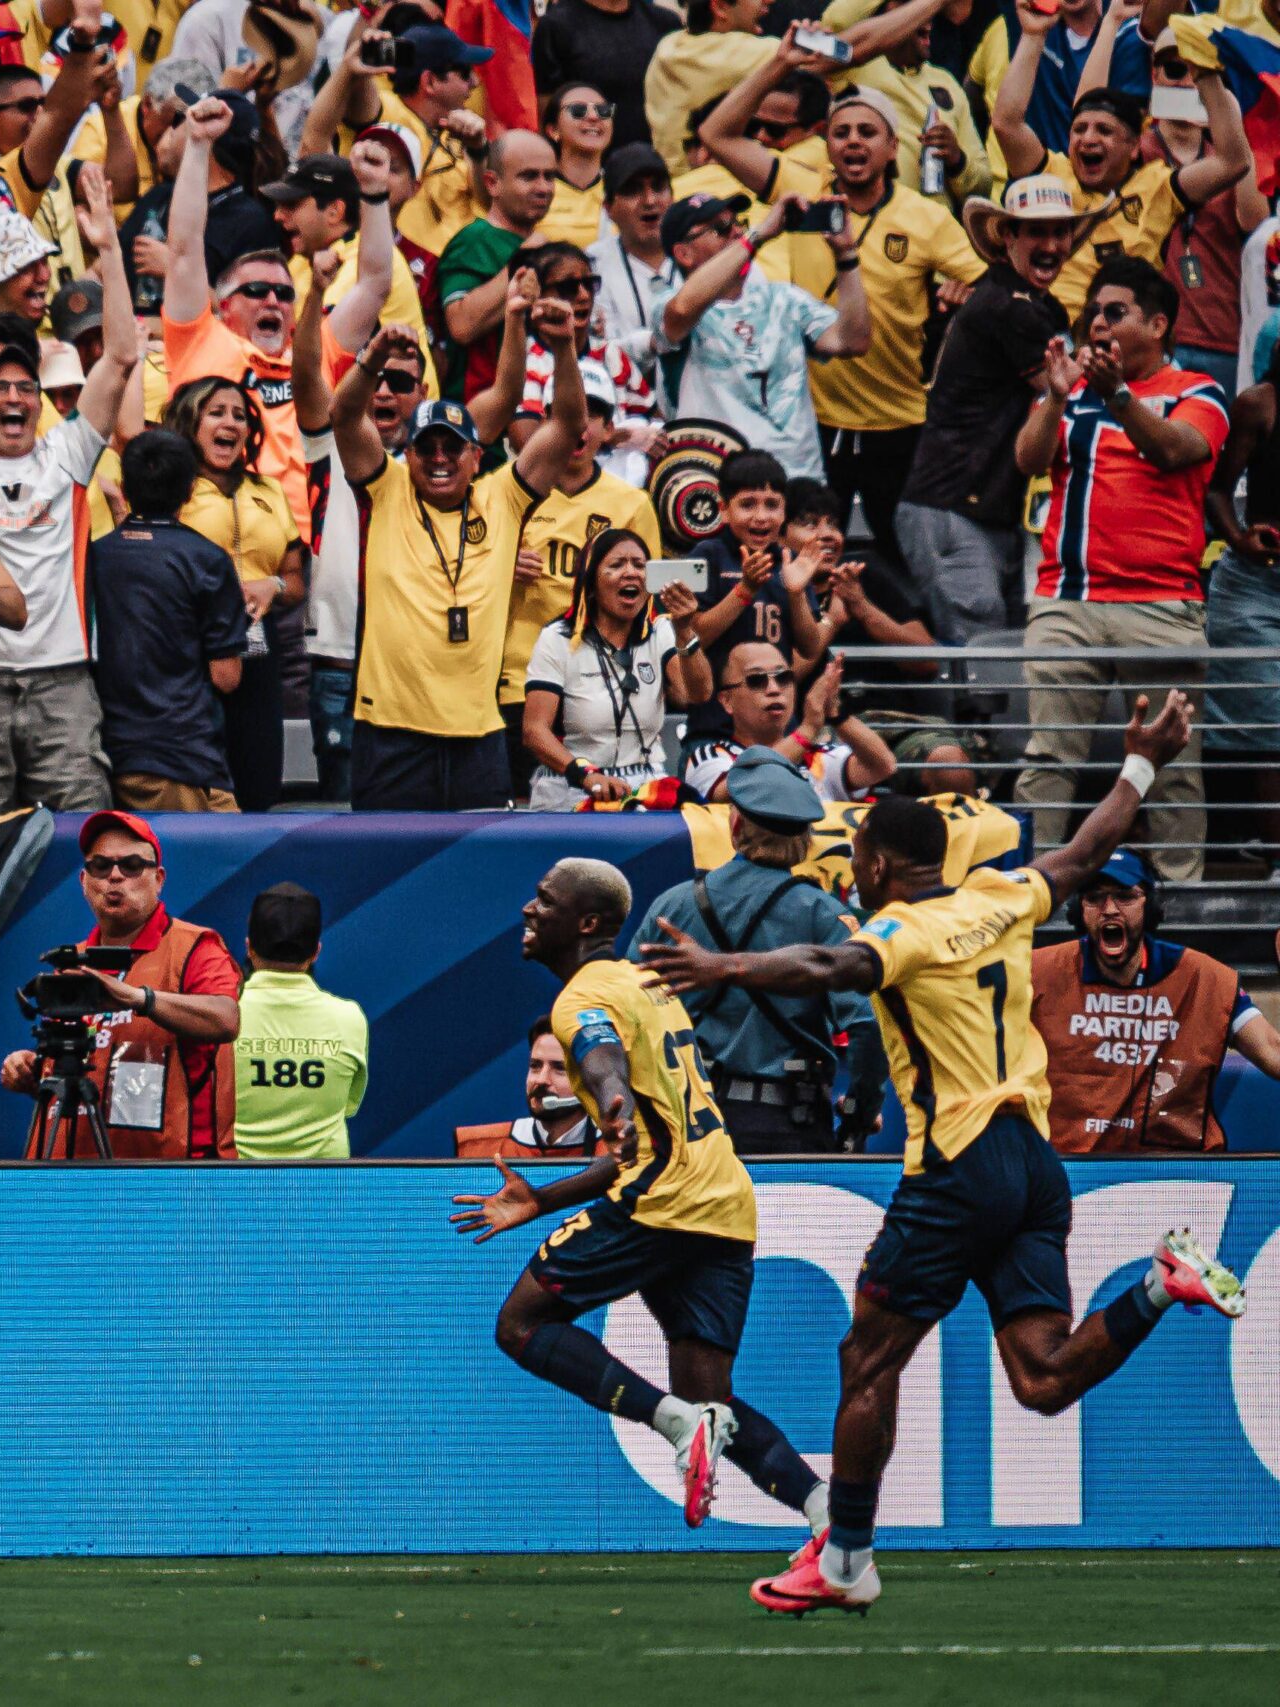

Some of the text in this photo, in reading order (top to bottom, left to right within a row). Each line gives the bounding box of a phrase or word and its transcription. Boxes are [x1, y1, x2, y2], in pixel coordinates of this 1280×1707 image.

[546, 539, 581, 577] 10
[754, 601, 781, 643] 16
[1084, 992, 1174, 1017] MEDIA
[1069, 1013, 1180, 1041] PARTNER
[237, 1037, 341, 1056] SECURITY
[1094, 1040, 1158, 1066] 4637
[250, 1058, 325, 1088] 186
[603, 1180, 1280, 1527] ar
